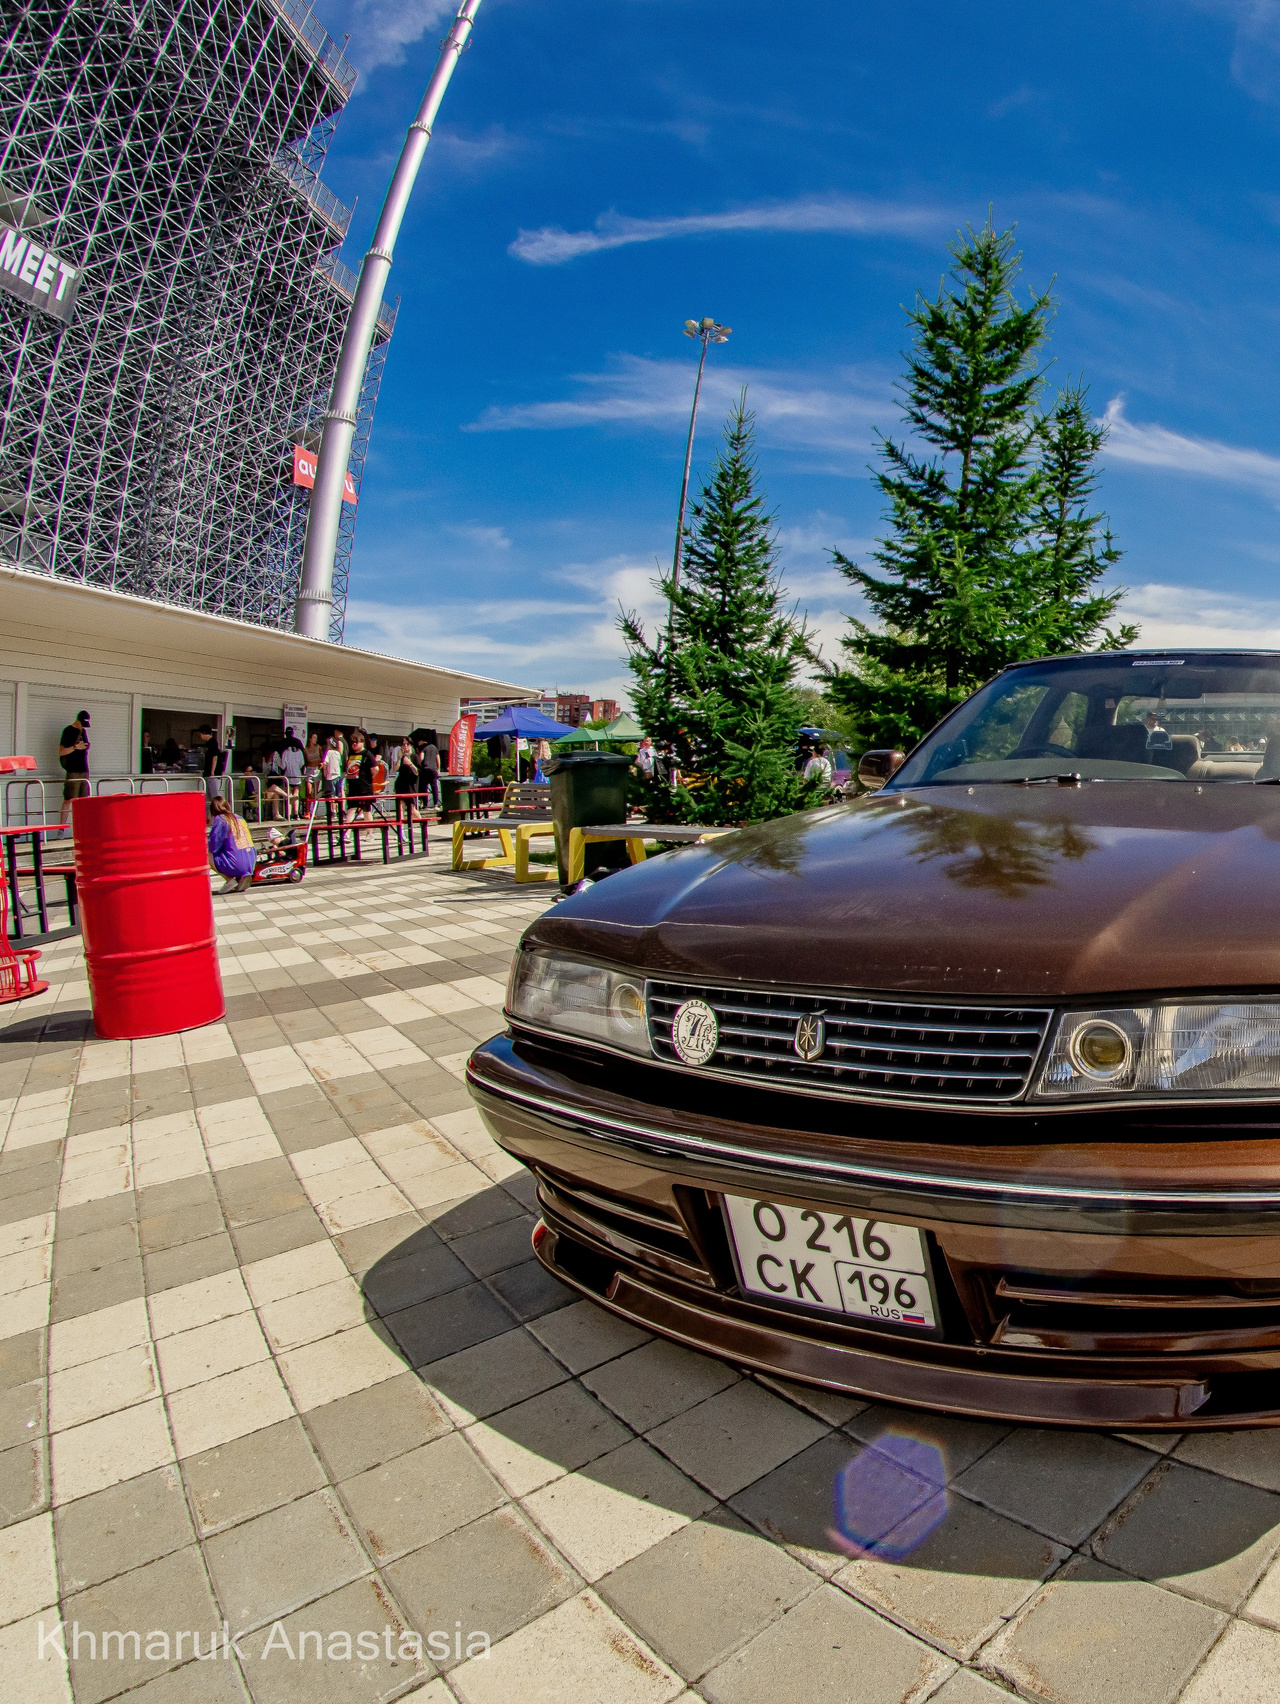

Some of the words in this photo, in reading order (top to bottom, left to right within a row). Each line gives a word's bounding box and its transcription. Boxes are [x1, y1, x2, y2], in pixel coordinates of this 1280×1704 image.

[0, 228, 77, 301] MEET
[686, 1000, 709, 1011] JAPAN
[800, 1210, 892, 1262] 216
[847, 1270, 917, 1309] 196
[869, 1305, 901, 1320] RUS
